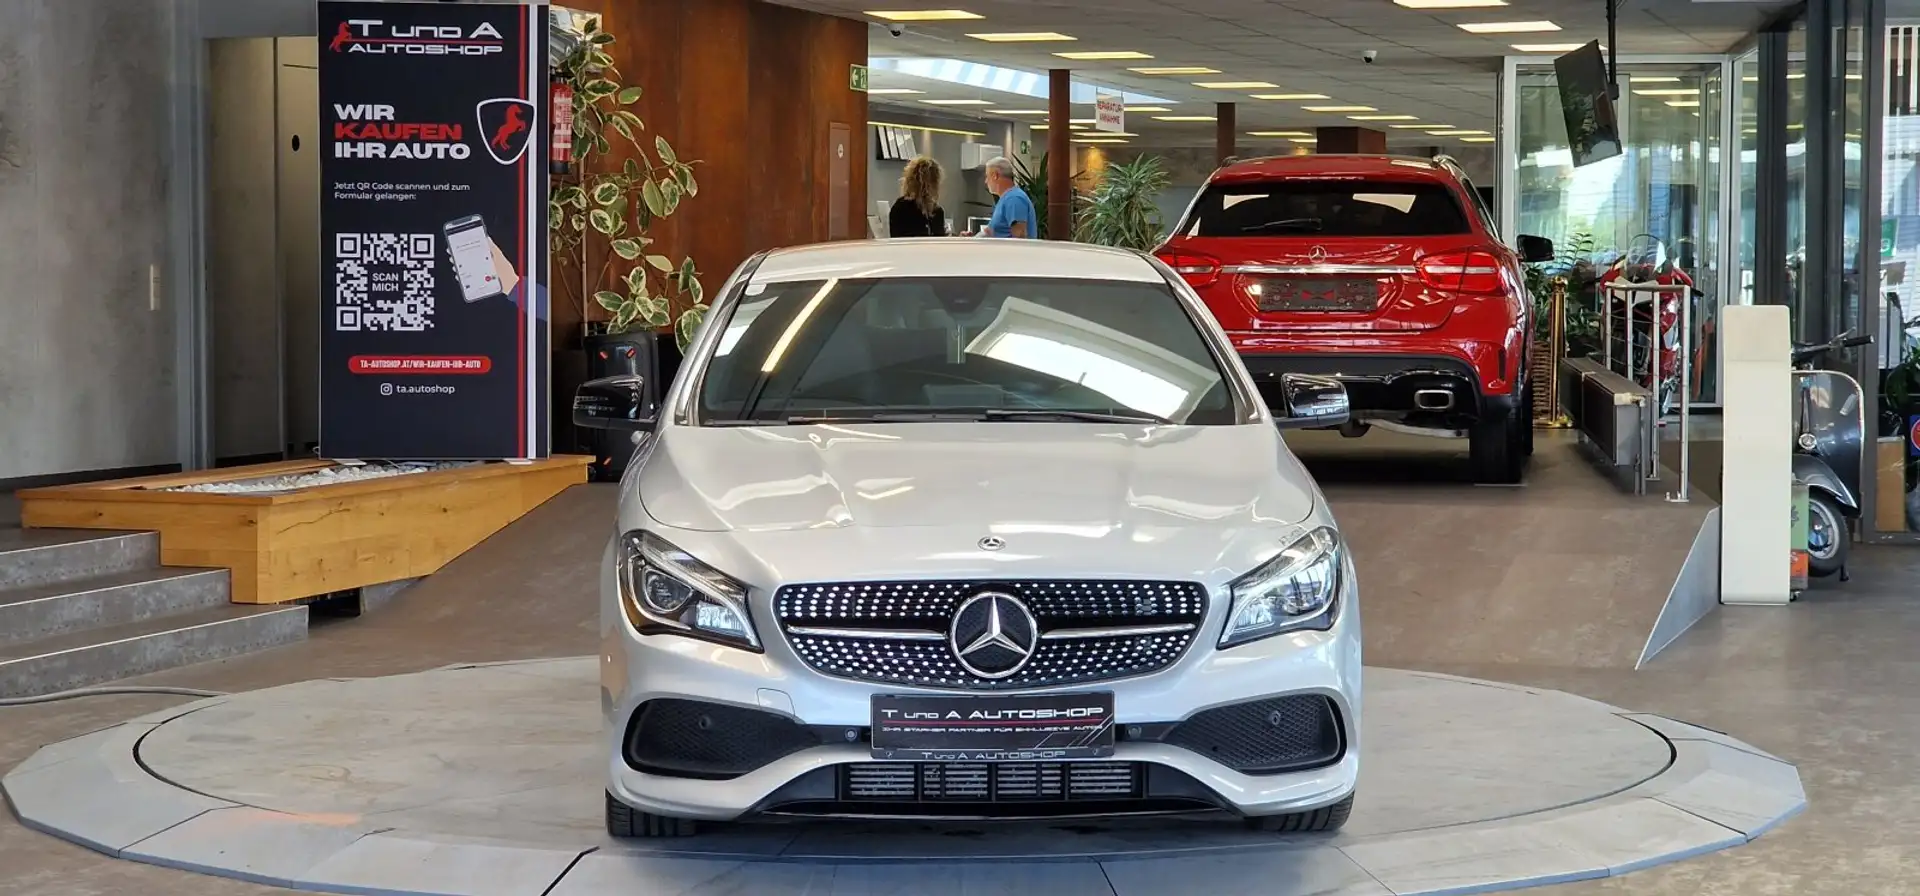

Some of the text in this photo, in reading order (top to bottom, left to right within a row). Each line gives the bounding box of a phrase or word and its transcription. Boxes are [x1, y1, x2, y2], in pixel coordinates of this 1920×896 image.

[348, 19, 384, 37] T
[468, 21, 504, 40] A
[348, 43, 503, 56] AUTOSHOP
[333, 103, 395, 121] WIR
[334, 123, 462, 141] KAUFEN
[334, 142, 471, 160] IHR AUTO
[333, 181, 355, 191] Jetzt
[356, 182, 370, 191] QR
[371, 182, 394, 191] Code
[395, 183, 431, 191] scannen
[432, 183, 450, 192] und
[334, 191, 416, 202] Formular gelangen:
[371, 272, 399, 282] SCAN
[371, 282, 399, 292] MICH
[396, 384, 456, 396] ta.autoshop
[881, 709, 898, 719] T
[945, 709, 962, 719] A
[968, 706, 1104, 719] AUTOSHOP
[921, 752, 932, 760] T
[957, 752, 969, 760] A
[975, 750, 1066, 760] AUTOSHOP
